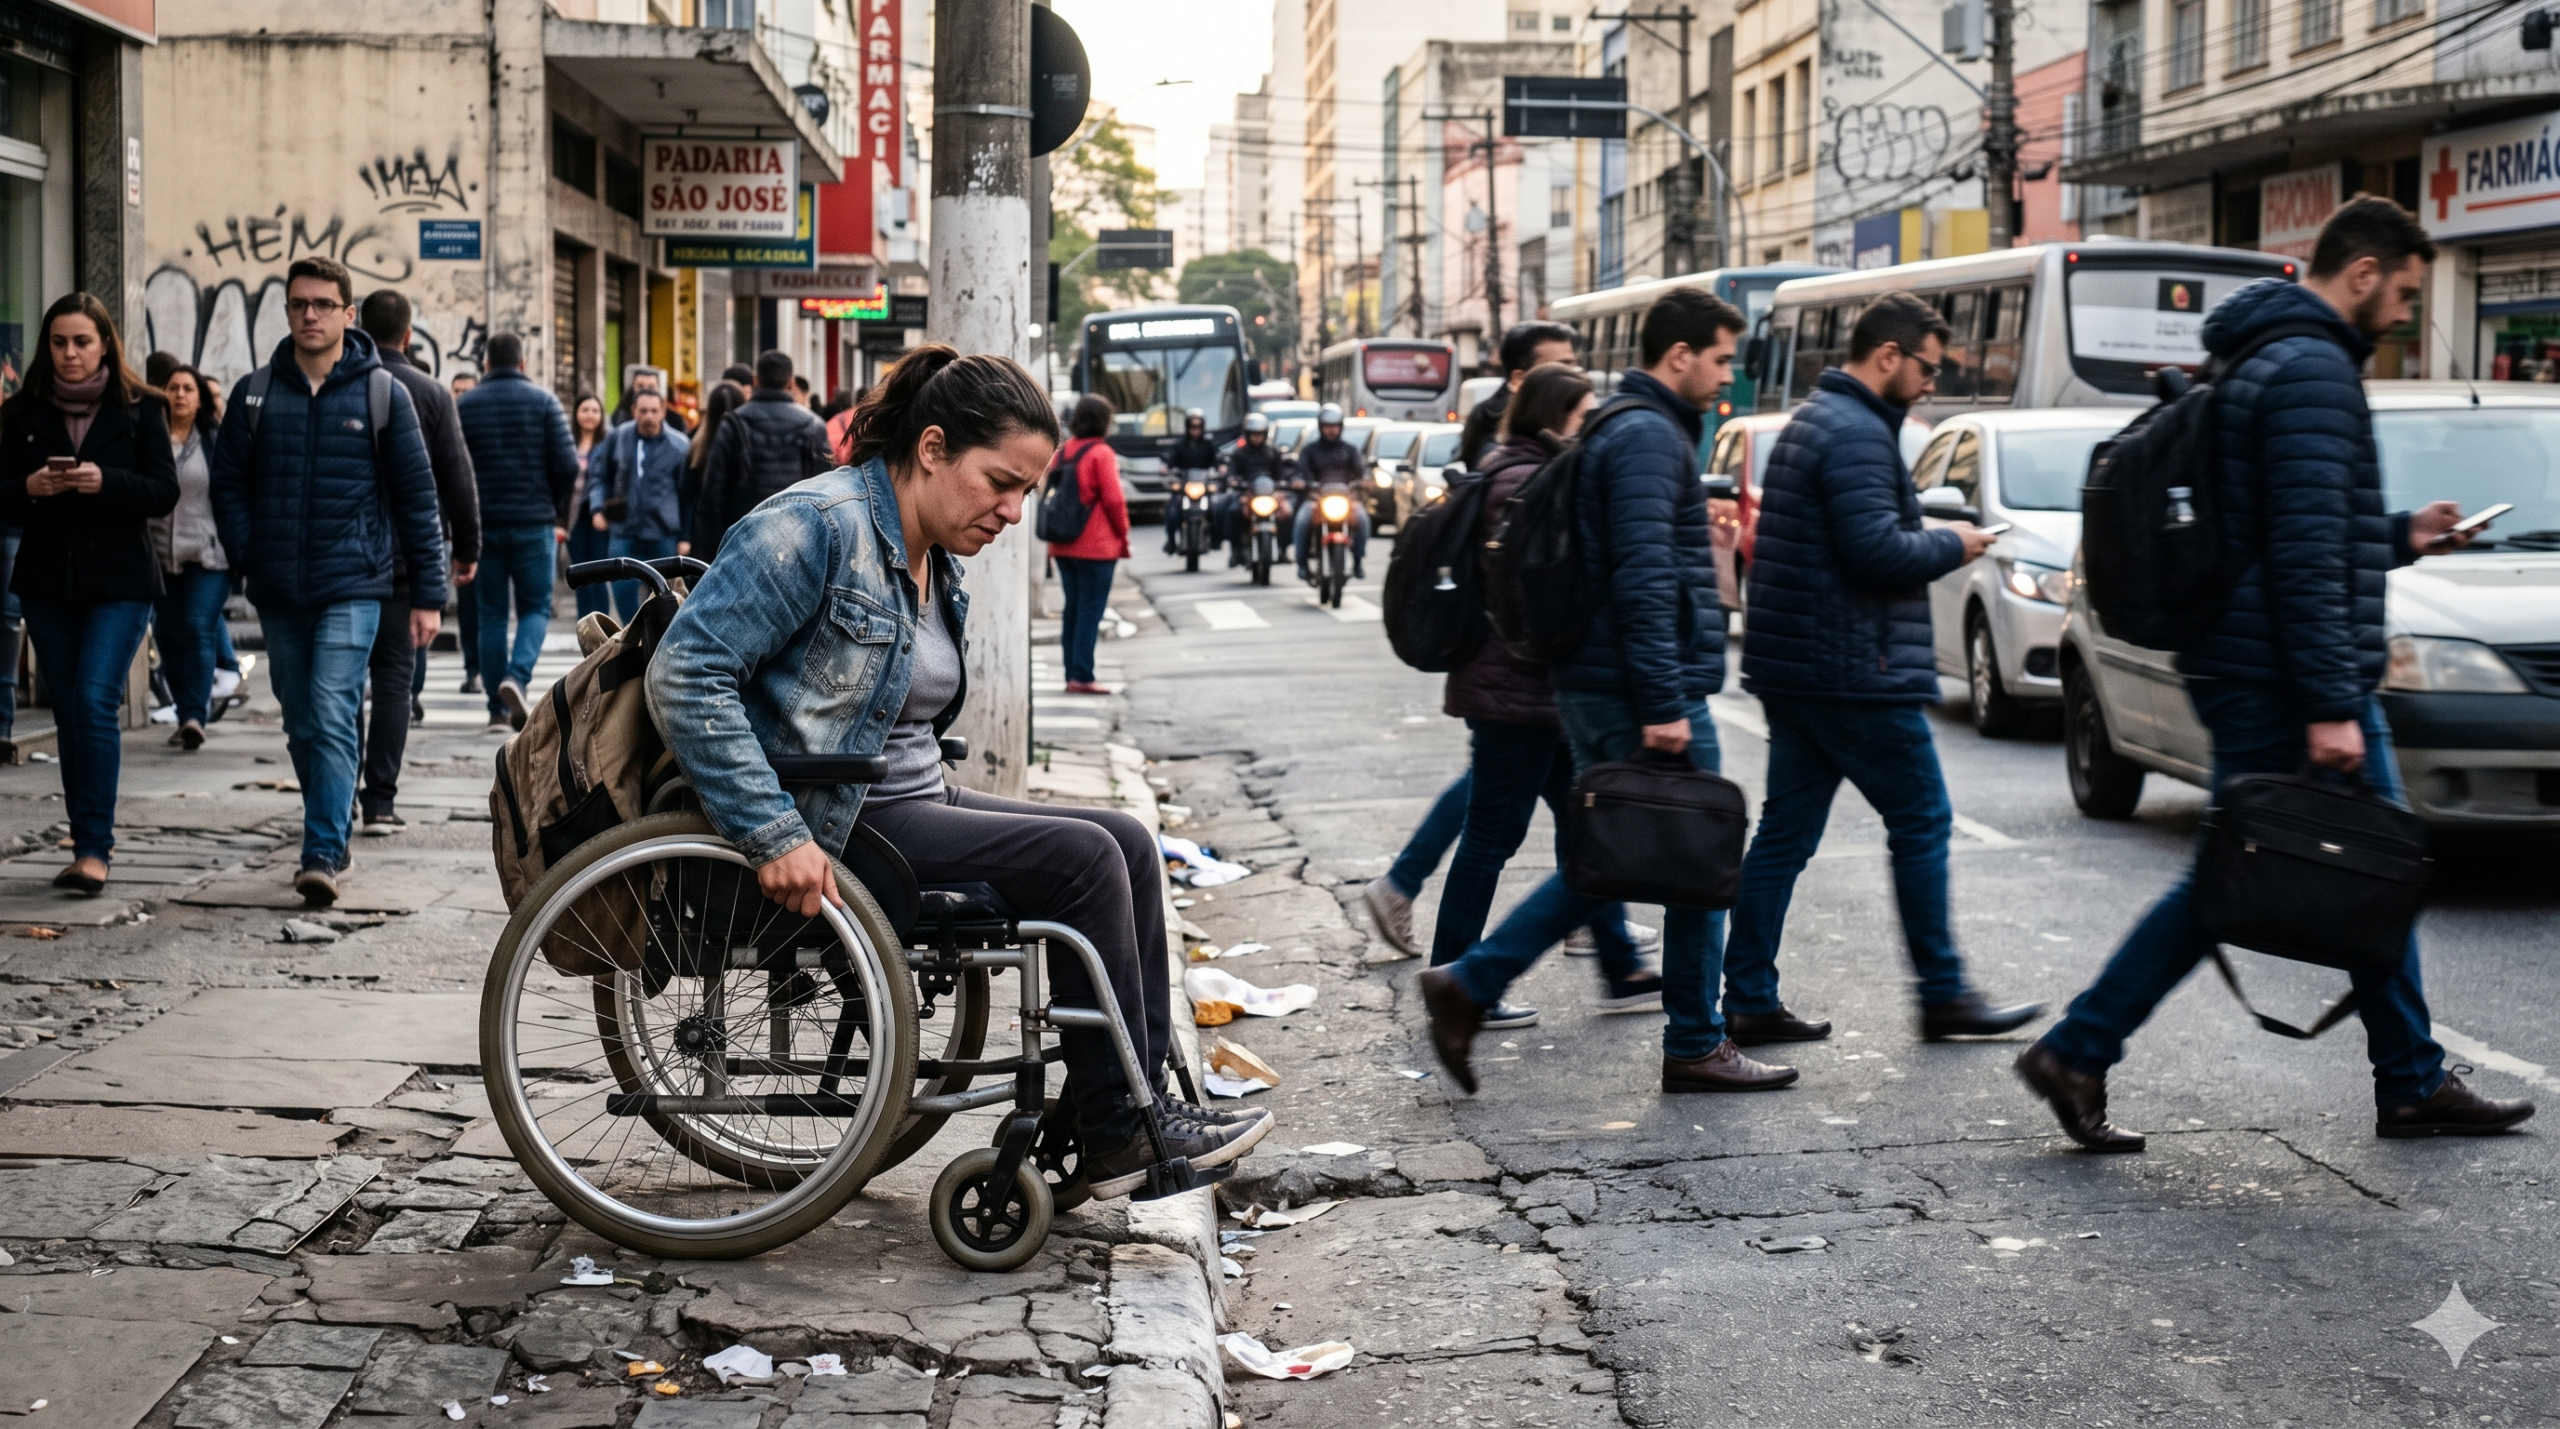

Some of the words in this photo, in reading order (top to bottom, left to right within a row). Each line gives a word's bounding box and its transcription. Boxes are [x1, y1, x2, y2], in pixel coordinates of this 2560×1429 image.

[655, 145, 783, 174] PADARIA
[651, 176, 707, 212] SÃO
[716, 179, 787, 213] JOSÉ
